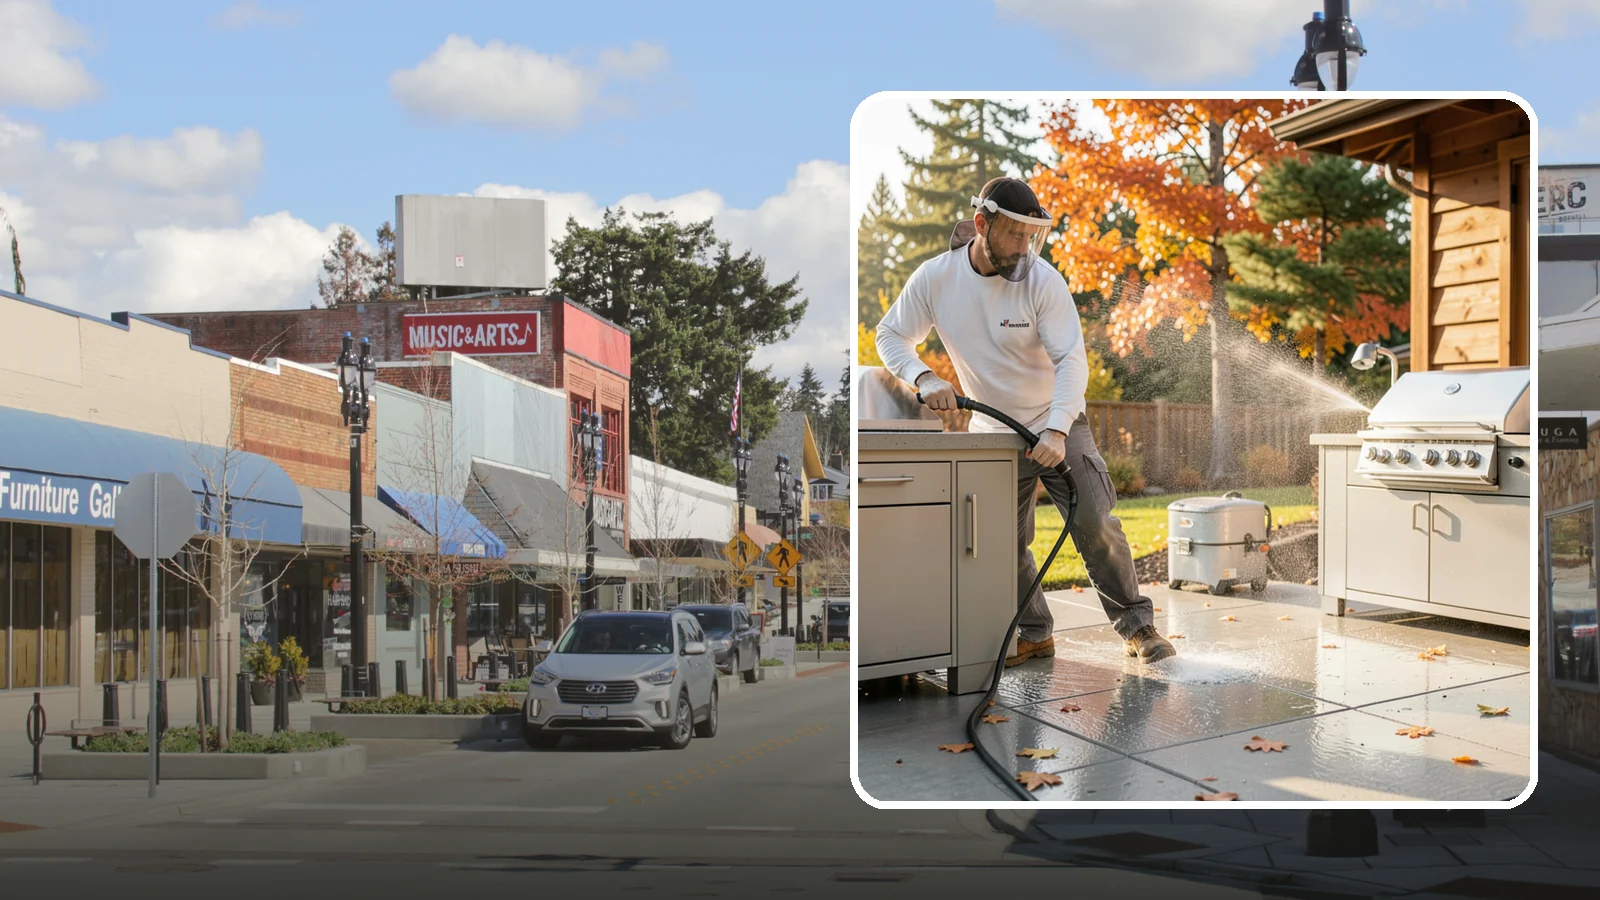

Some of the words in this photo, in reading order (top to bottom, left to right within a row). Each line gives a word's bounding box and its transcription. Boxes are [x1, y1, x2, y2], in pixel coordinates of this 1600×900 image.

[409, 323, 519, 348] MUSIC&ARTS
[0, 471, 79, 516] Furniture
[90, 482, 122, 519] Gal
